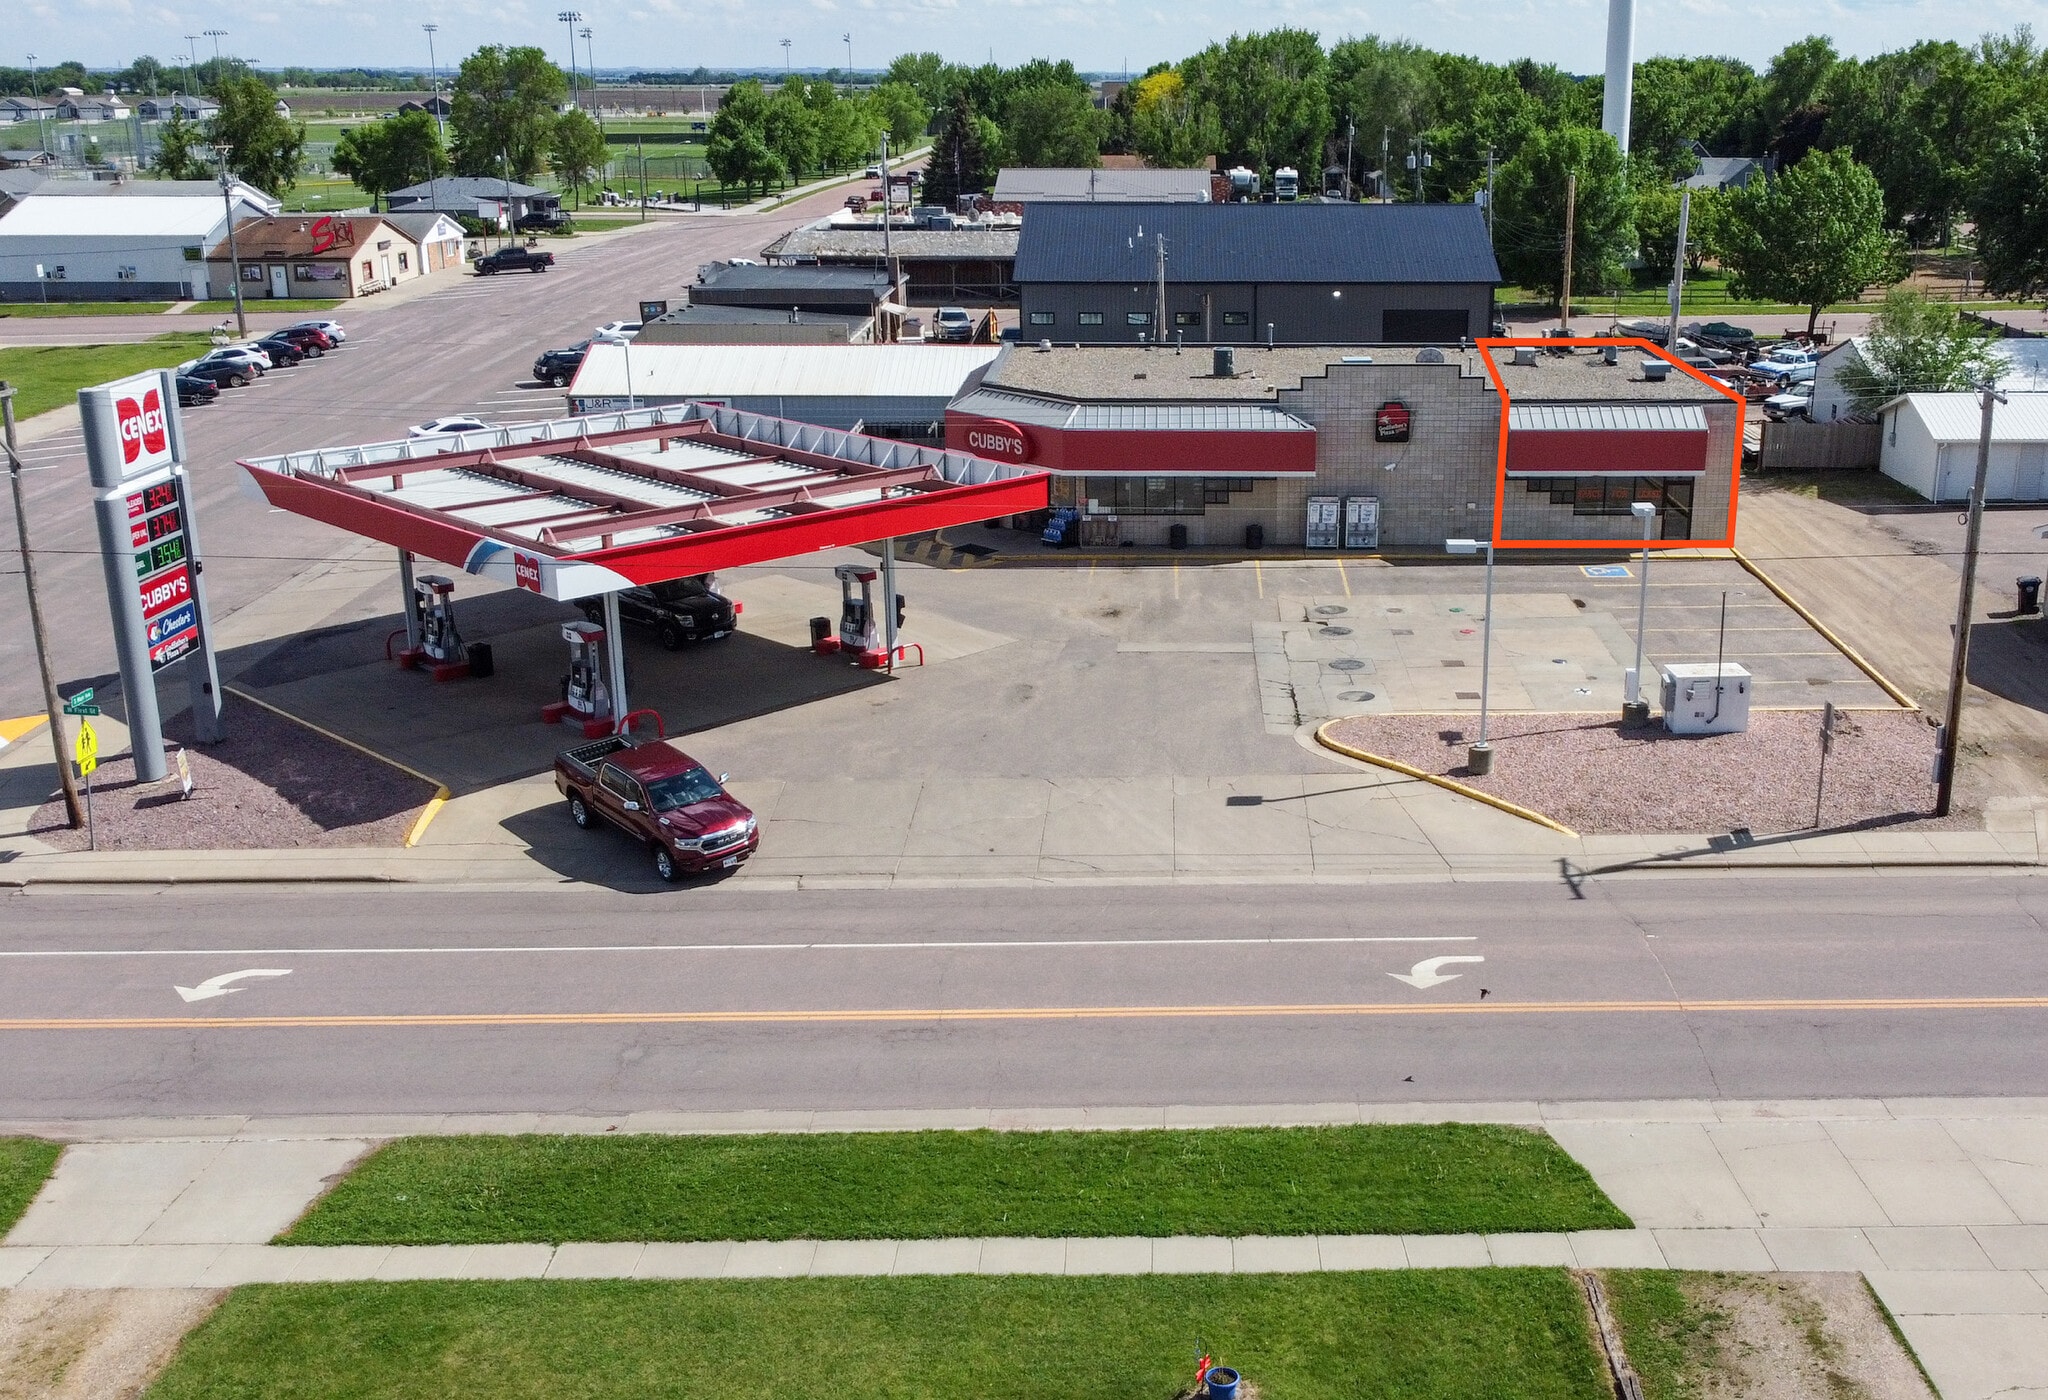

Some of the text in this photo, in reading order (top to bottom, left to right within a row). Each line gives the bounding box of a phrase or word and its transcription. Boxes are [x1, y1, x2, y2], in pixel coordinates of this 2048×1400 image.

[585, 398, 612, 409] J&R
[121, 408, 163, 441] CENEX
[969, 431, 1023, 455] CUBBY'S
[516, 564, 539, 582] CENEX
